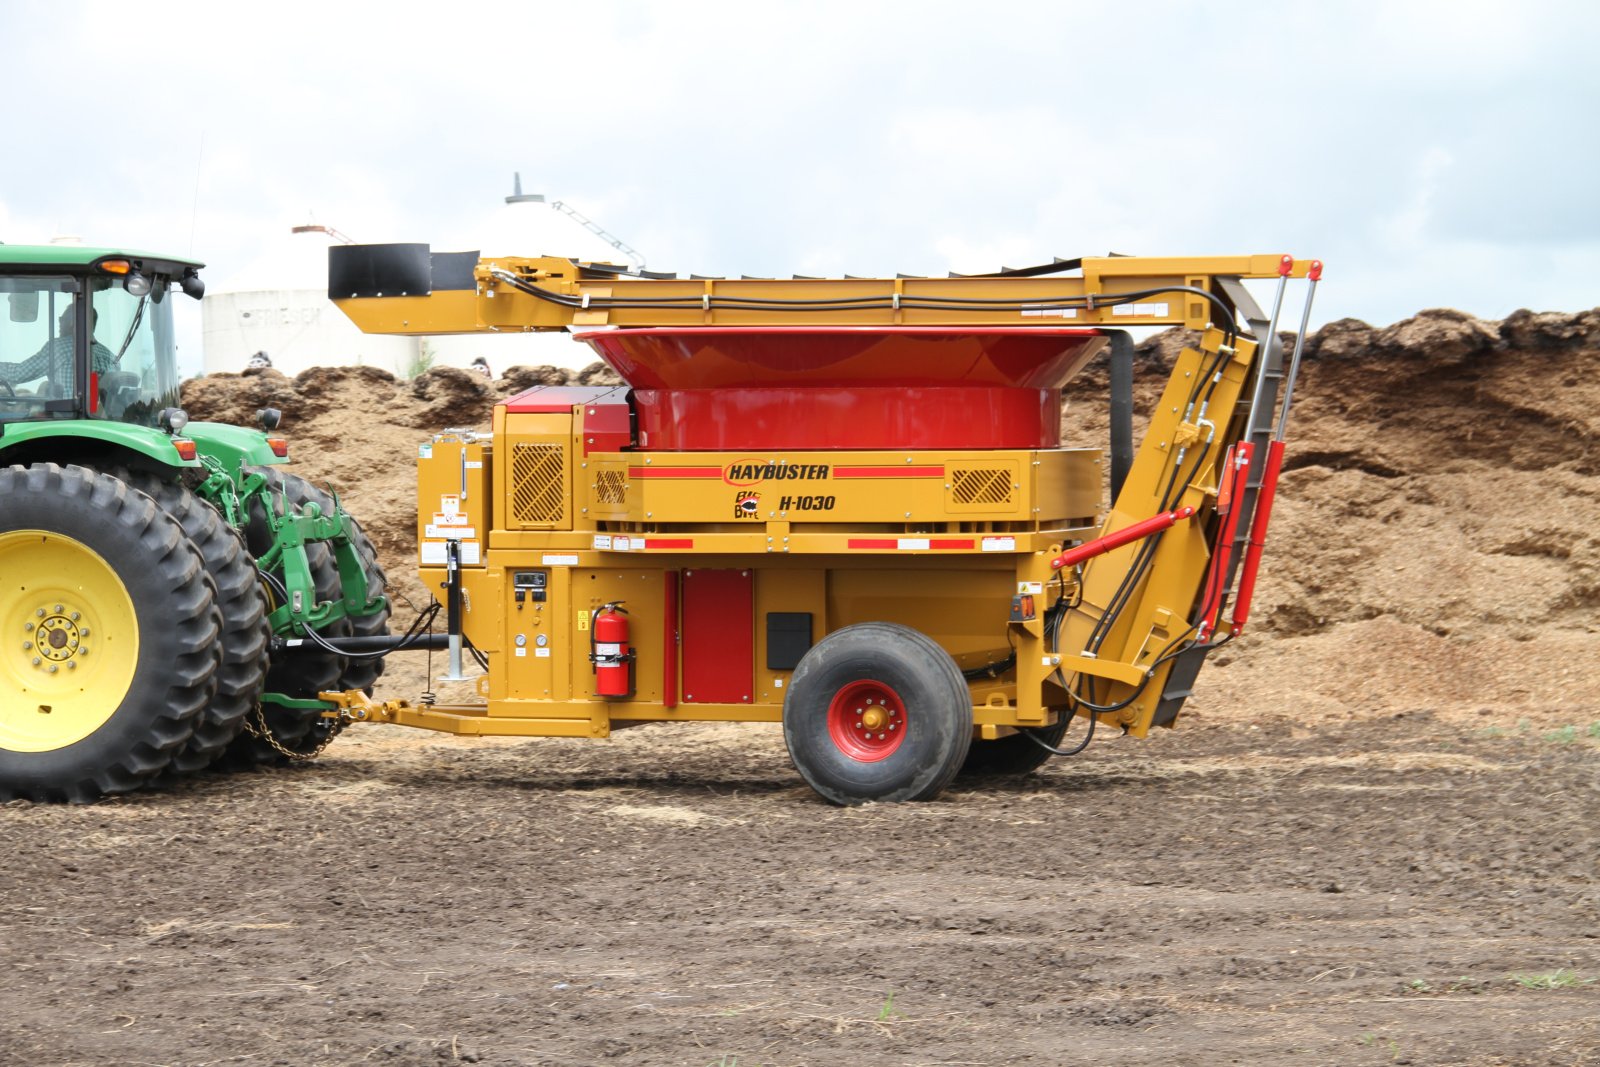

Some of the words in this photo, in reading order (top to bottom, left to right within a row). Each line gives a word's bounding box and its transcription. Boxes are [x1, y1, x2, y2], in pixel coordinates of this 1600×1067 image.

[729, 464, 829, 480] HAYBUSTER
[779, 495, 836, 511] H-1030
[734, 504, 760, 520] BITE
